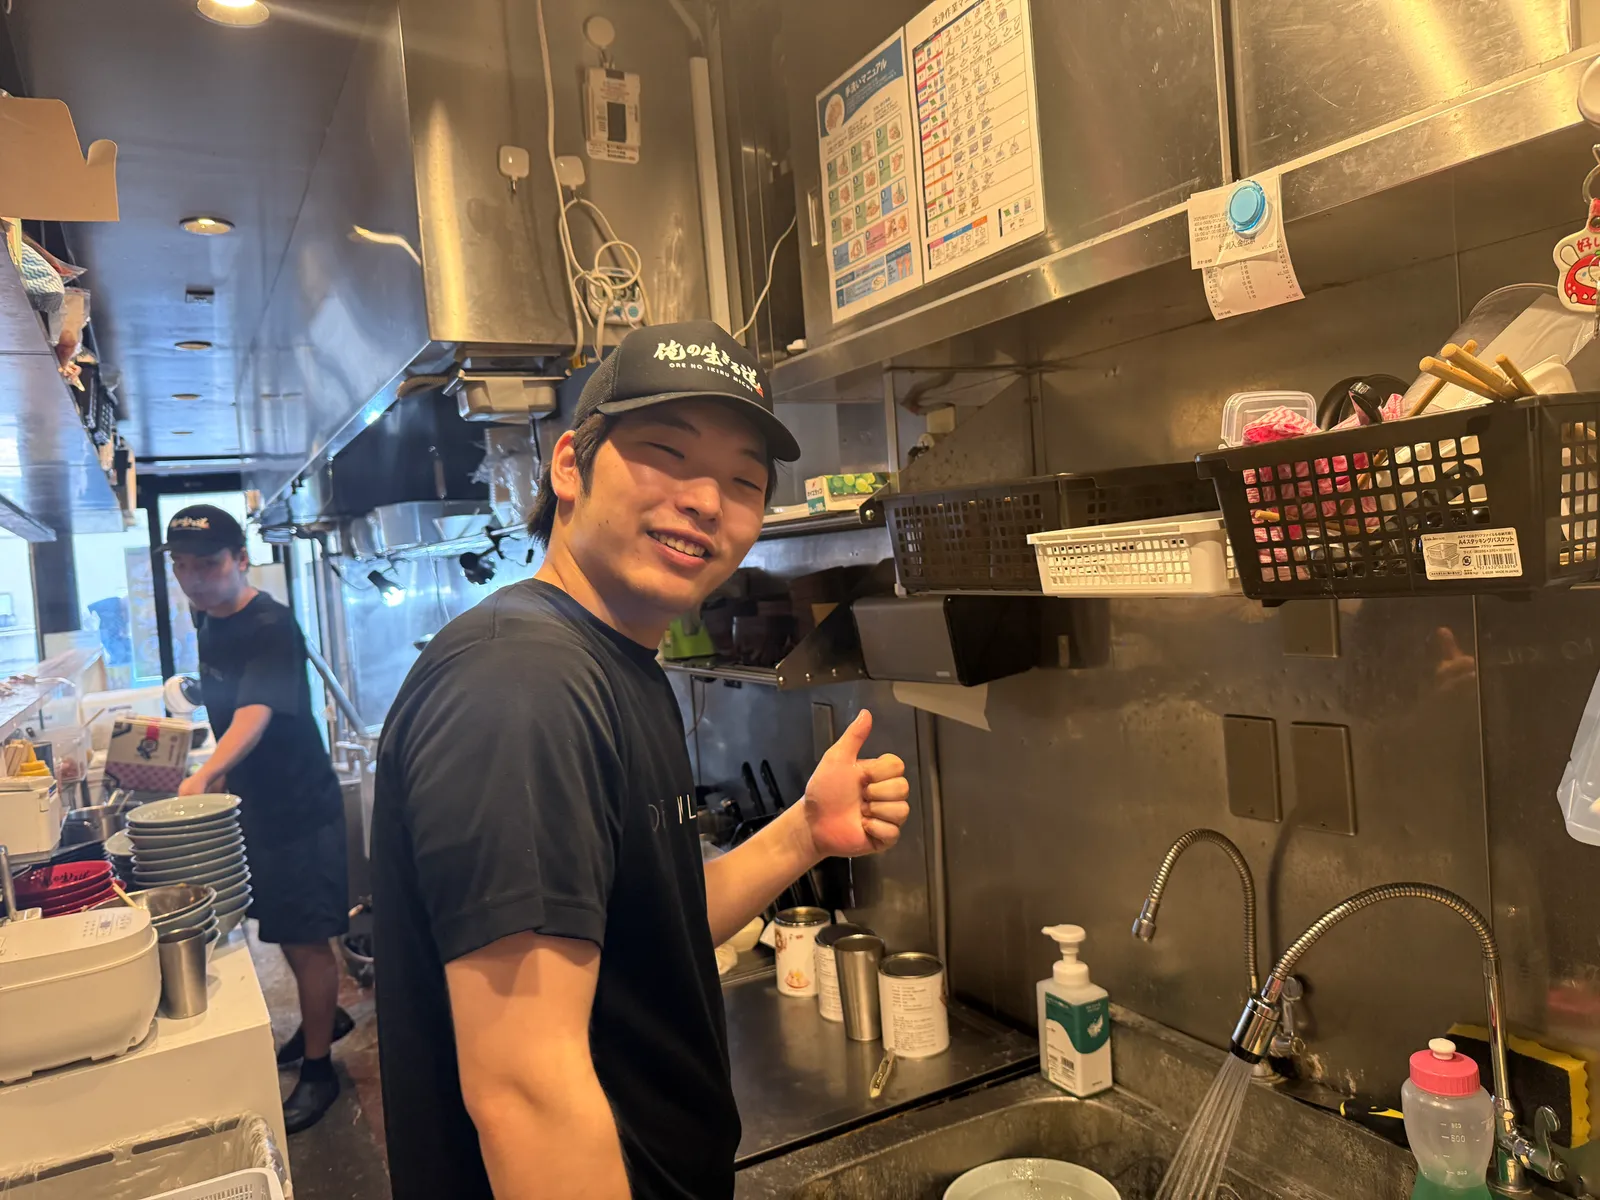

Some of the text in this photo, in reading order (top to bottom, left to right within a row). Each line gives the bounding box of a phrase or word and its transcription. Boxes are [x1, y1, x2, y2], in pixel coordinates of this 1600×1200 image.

[653, 340, 760, 388] 俺の生きる道
[706, 366, 729, 377] IKIRU
[1458, 536, 1515, 546] A4スタッキングバスケット
